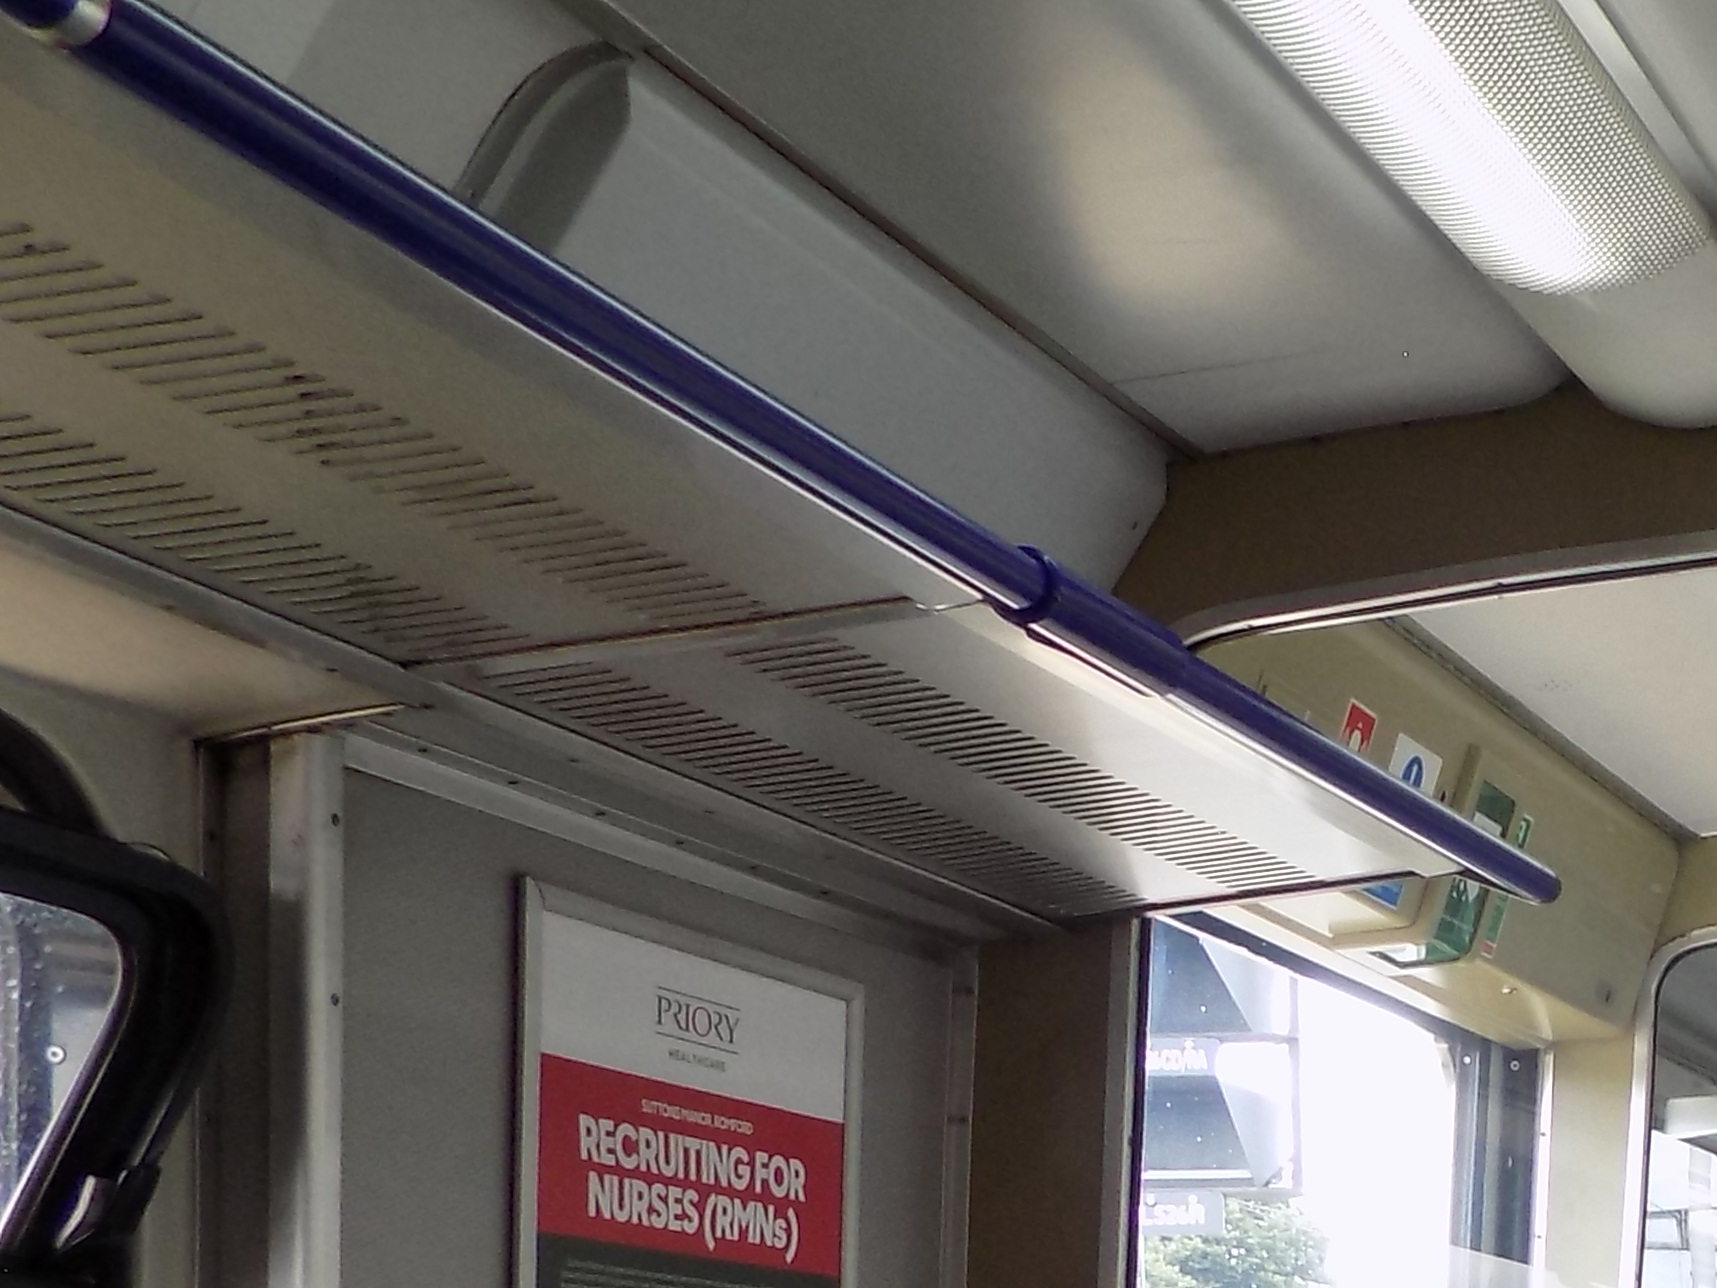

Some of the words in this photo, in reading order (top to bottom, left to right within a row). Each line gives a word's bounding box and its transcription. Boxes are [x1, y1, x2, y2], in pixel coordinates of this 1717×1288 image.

[656, 994, 741, 1044] PRIORY
[667, 1049, 727, 1073] HEALTHCARE
[578, 1113, 751, 1191] RECRUITING
[754, 1151, 807, 1203] FOR
[587, 1170, 702, 1236] NURSES
[702, 1193, 800, 1265] (RMNs)
